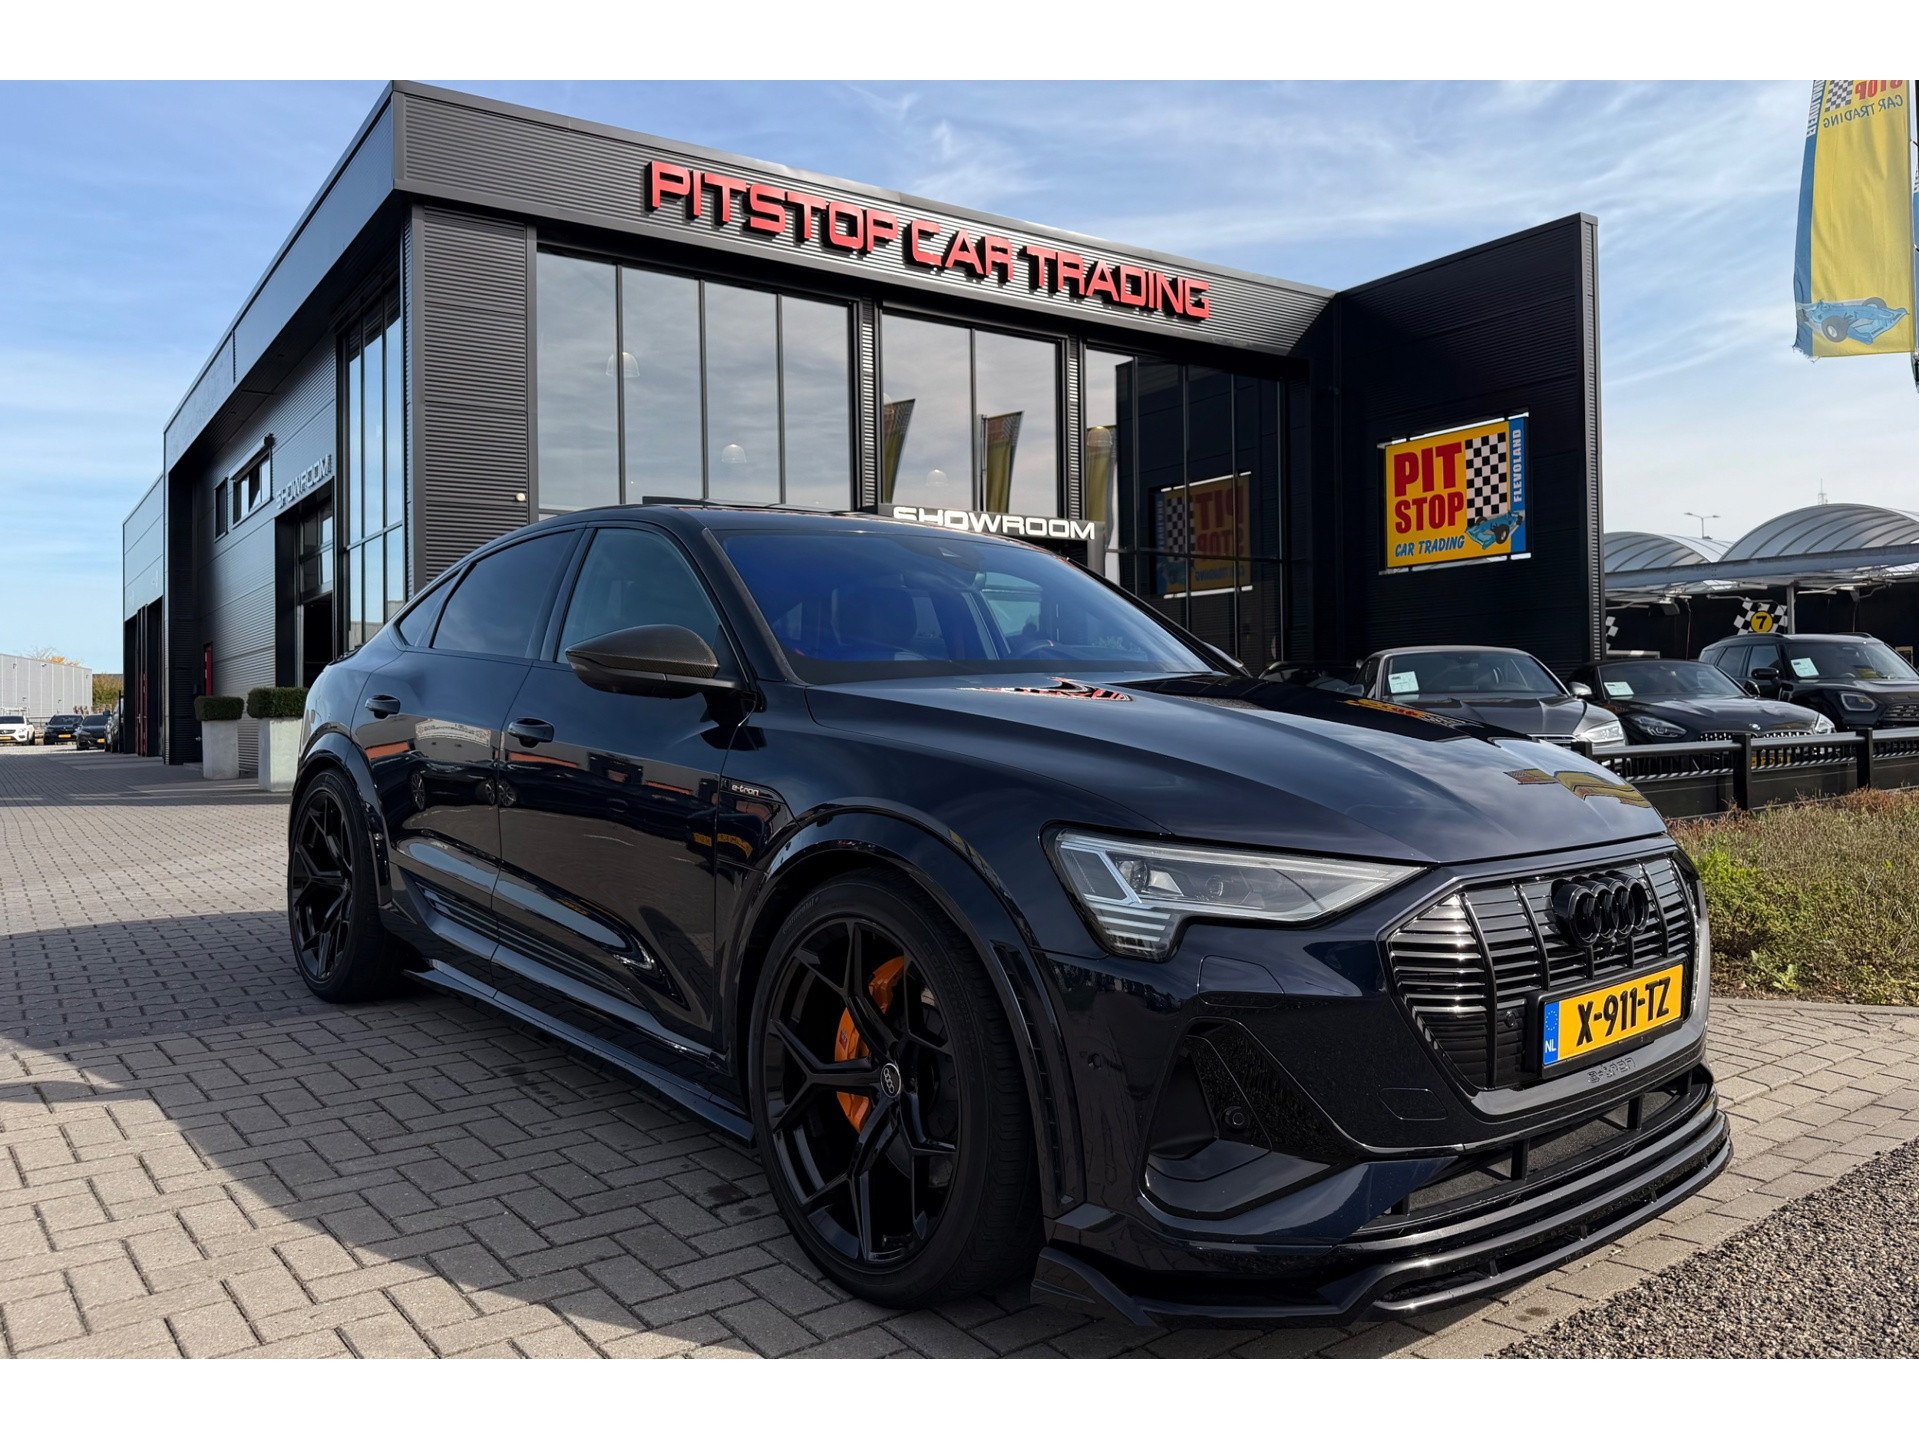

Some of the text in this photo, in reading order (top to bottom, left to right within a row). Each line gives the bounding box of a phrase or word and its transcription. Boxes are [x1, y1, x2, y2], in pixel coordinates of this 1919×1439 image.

[651, 160, 1211, 319] PITSTOP CAR TRADING
[1394, 441, 1462, 498] PIT
[1512, 429, 1523, 503] FLEVOLAND
[893, 506, 1095, 540] SHOWROOM
[1395, 491, 1464, 535] STOP
[1395, 535, 1465, 558] CAR TRADING
[1755, 615, 1768, 630] 7
[731, 784, 760, 797] e-tron
[1576, 976, 1671, 1047] X-911-TZ
[1544, 1038, 1557, 1054] NL
